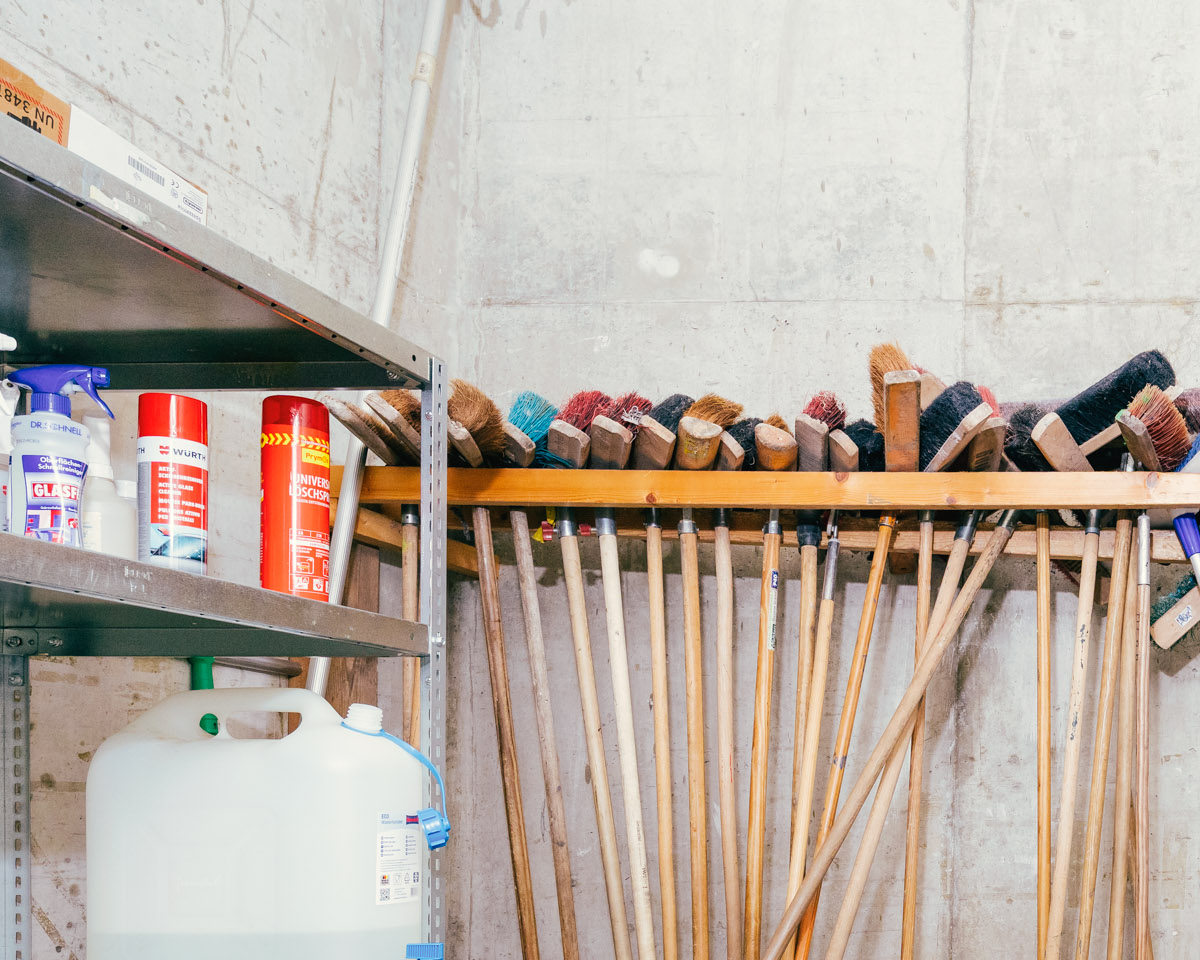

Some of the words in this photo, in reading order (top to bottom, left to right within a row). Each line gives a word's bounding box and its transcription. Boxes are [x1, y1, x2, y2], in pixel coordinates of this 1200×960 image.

[0, 84, 31, 113] 348
[35, 106, 55, 129] UN
[173, 448, 206, 461] WÜRTH
